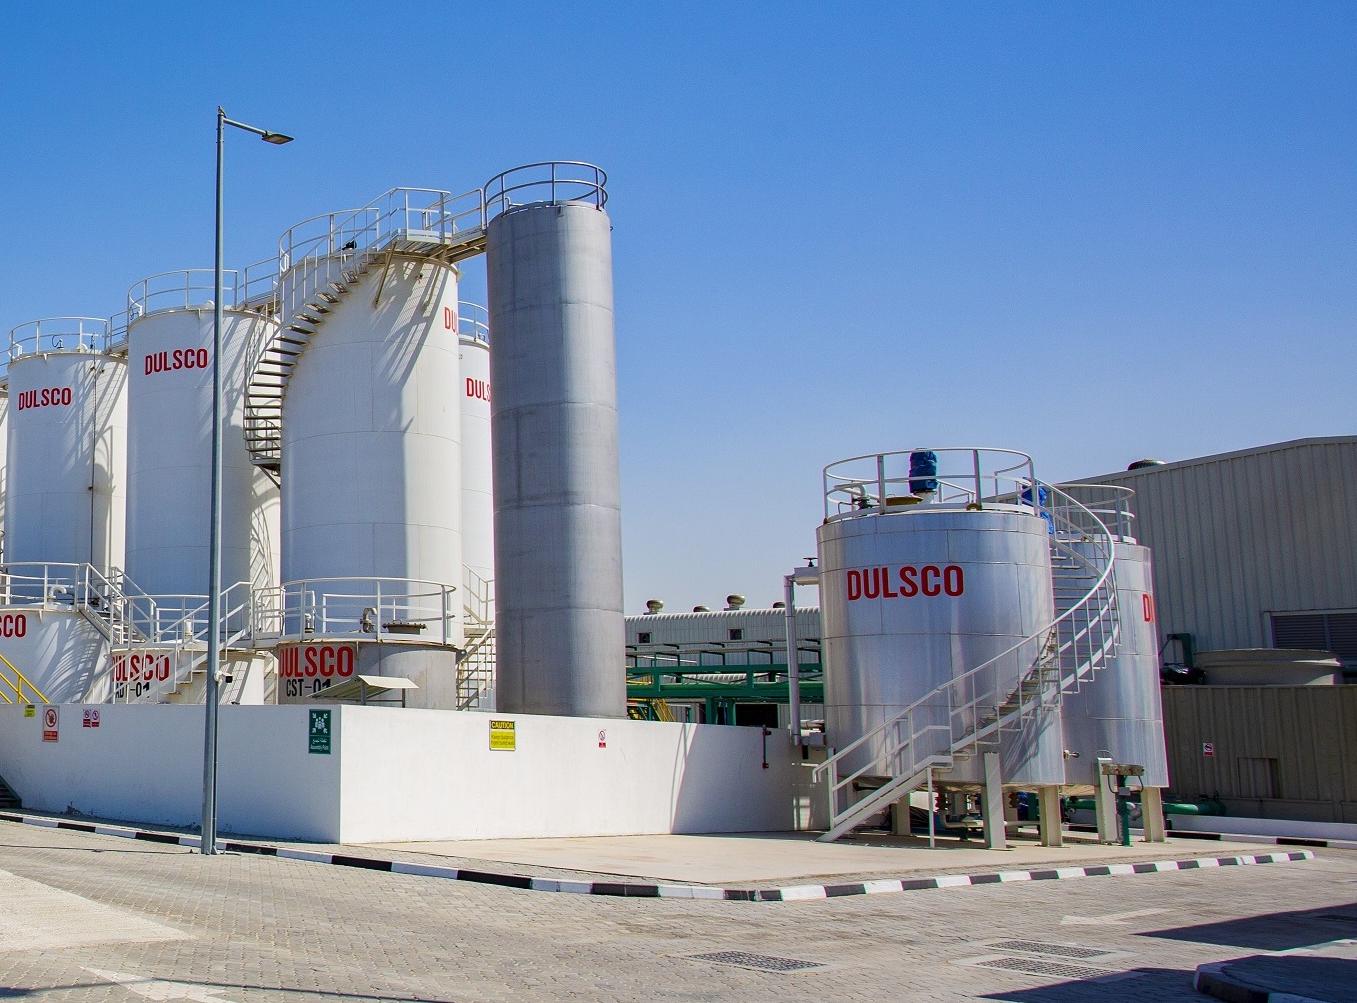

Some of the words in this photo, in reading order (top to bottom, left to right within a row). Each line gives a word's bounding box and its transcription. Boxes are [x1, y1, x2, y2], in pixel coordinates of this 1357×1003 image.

[144, 348, 208, 375] DULSCO
[18, 387, 72, 411] DULSCO
[847, 565, 965, 601] DULSCO
[491, 721, 514, 729] CAUTION
